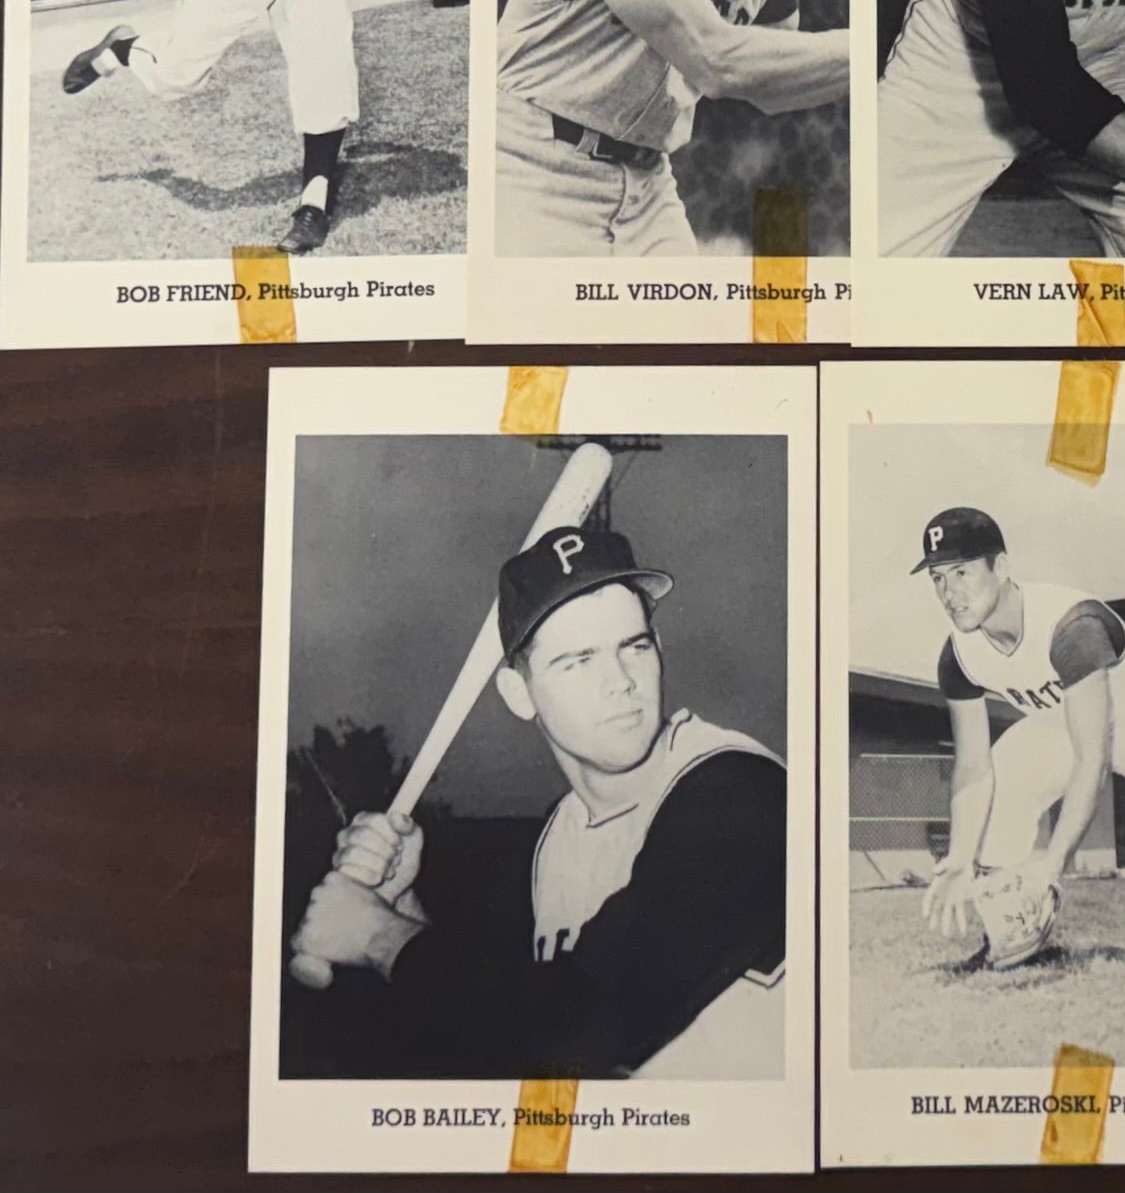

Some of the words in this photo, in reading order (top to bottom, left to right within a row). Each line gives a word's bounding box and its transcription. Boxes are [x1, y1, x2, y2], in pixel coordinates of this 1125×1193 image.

[116, 286, 160, 304] BOB
[166, 284, 252, 302] FRIEND,
[258, 281, 360, 301] Pittsburgh
[366, 280, 435, 297] Pirates
[575, 283, 619, 301] BILL
[626, 283, 719, 302] VIRDON,
[726, 283, 827, 303] Pittsburgh
[973, 283, 1032, 300] VERN
[1038, 283, 1095, 303] LAW,
[928, 525, 944, 551] P
[553, 534, 585, 575] P
[911, 1096, 957, 1114] BILL
[964, 1096, 1101, 1114] MAZEROSKI,
[371, 1109, 416, 1127] BOB
[422, 1108, 506, 1128] BAILEY,
[513, 1107, 615, 1130] Pittsburgh
[621, 1107, 690, 1126] Pirates
